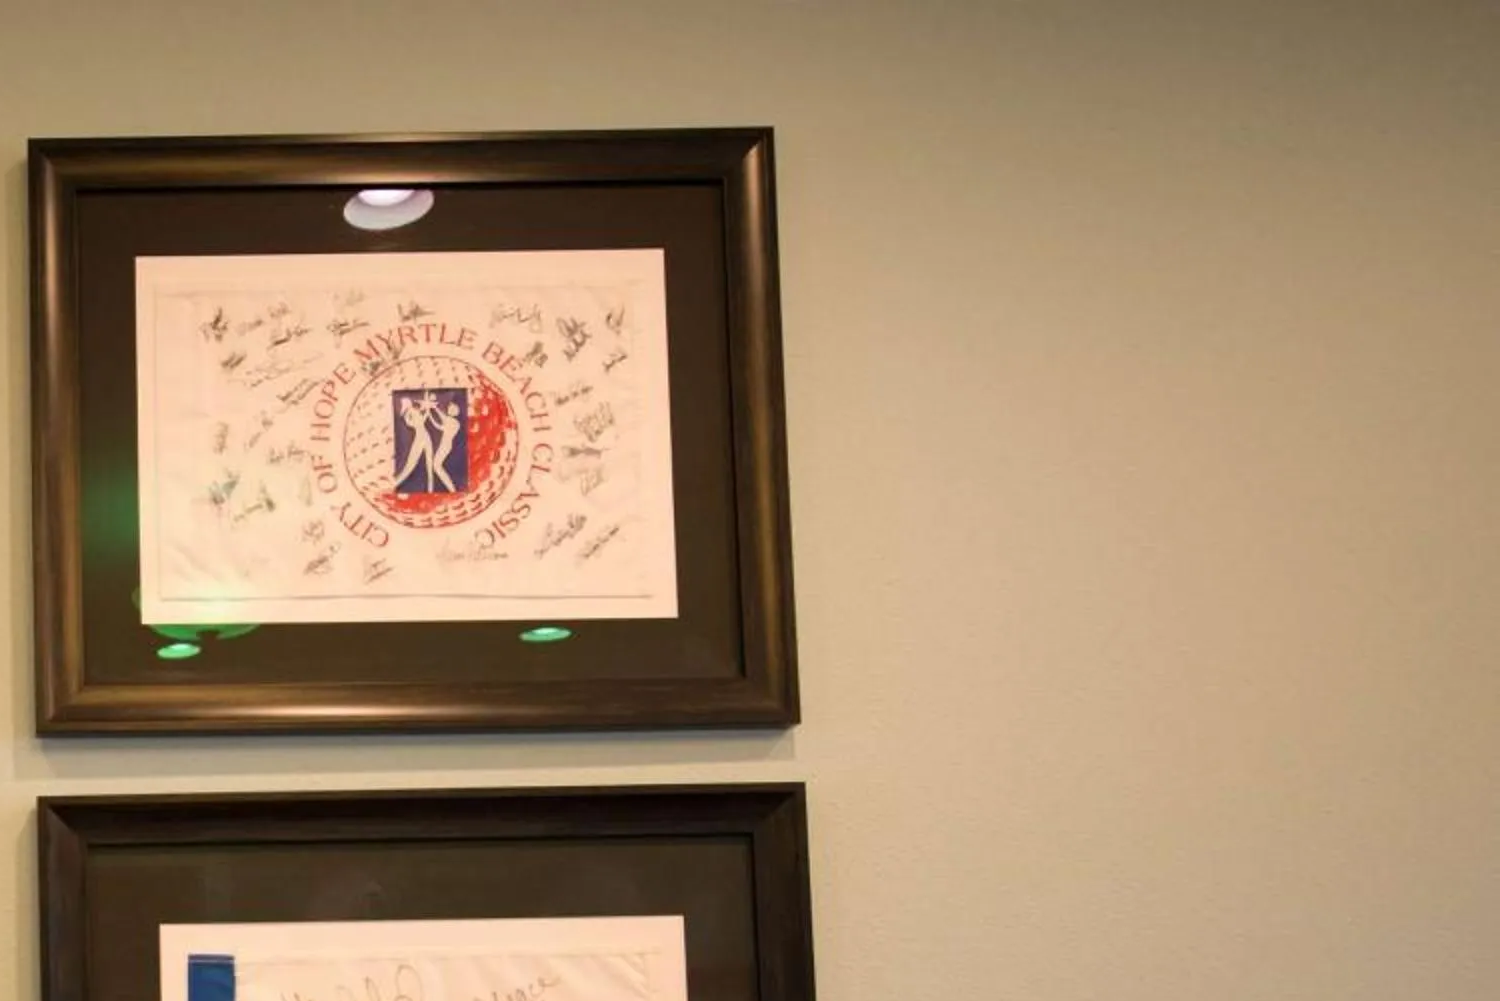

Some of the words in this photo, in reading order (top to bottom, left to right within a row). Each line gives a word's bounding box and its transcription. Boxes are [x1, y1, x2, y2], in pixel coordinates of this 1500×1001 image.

[353, 323, 477, 367] MYRTLE
[310, 362, 357, 442] HOPE
[481, 341, 552, 433] BEACH
[311, 454, 338, 494] OF
[474, 443, 554, 550] CLASSIC
[330, 501, 390, 548] CITY
